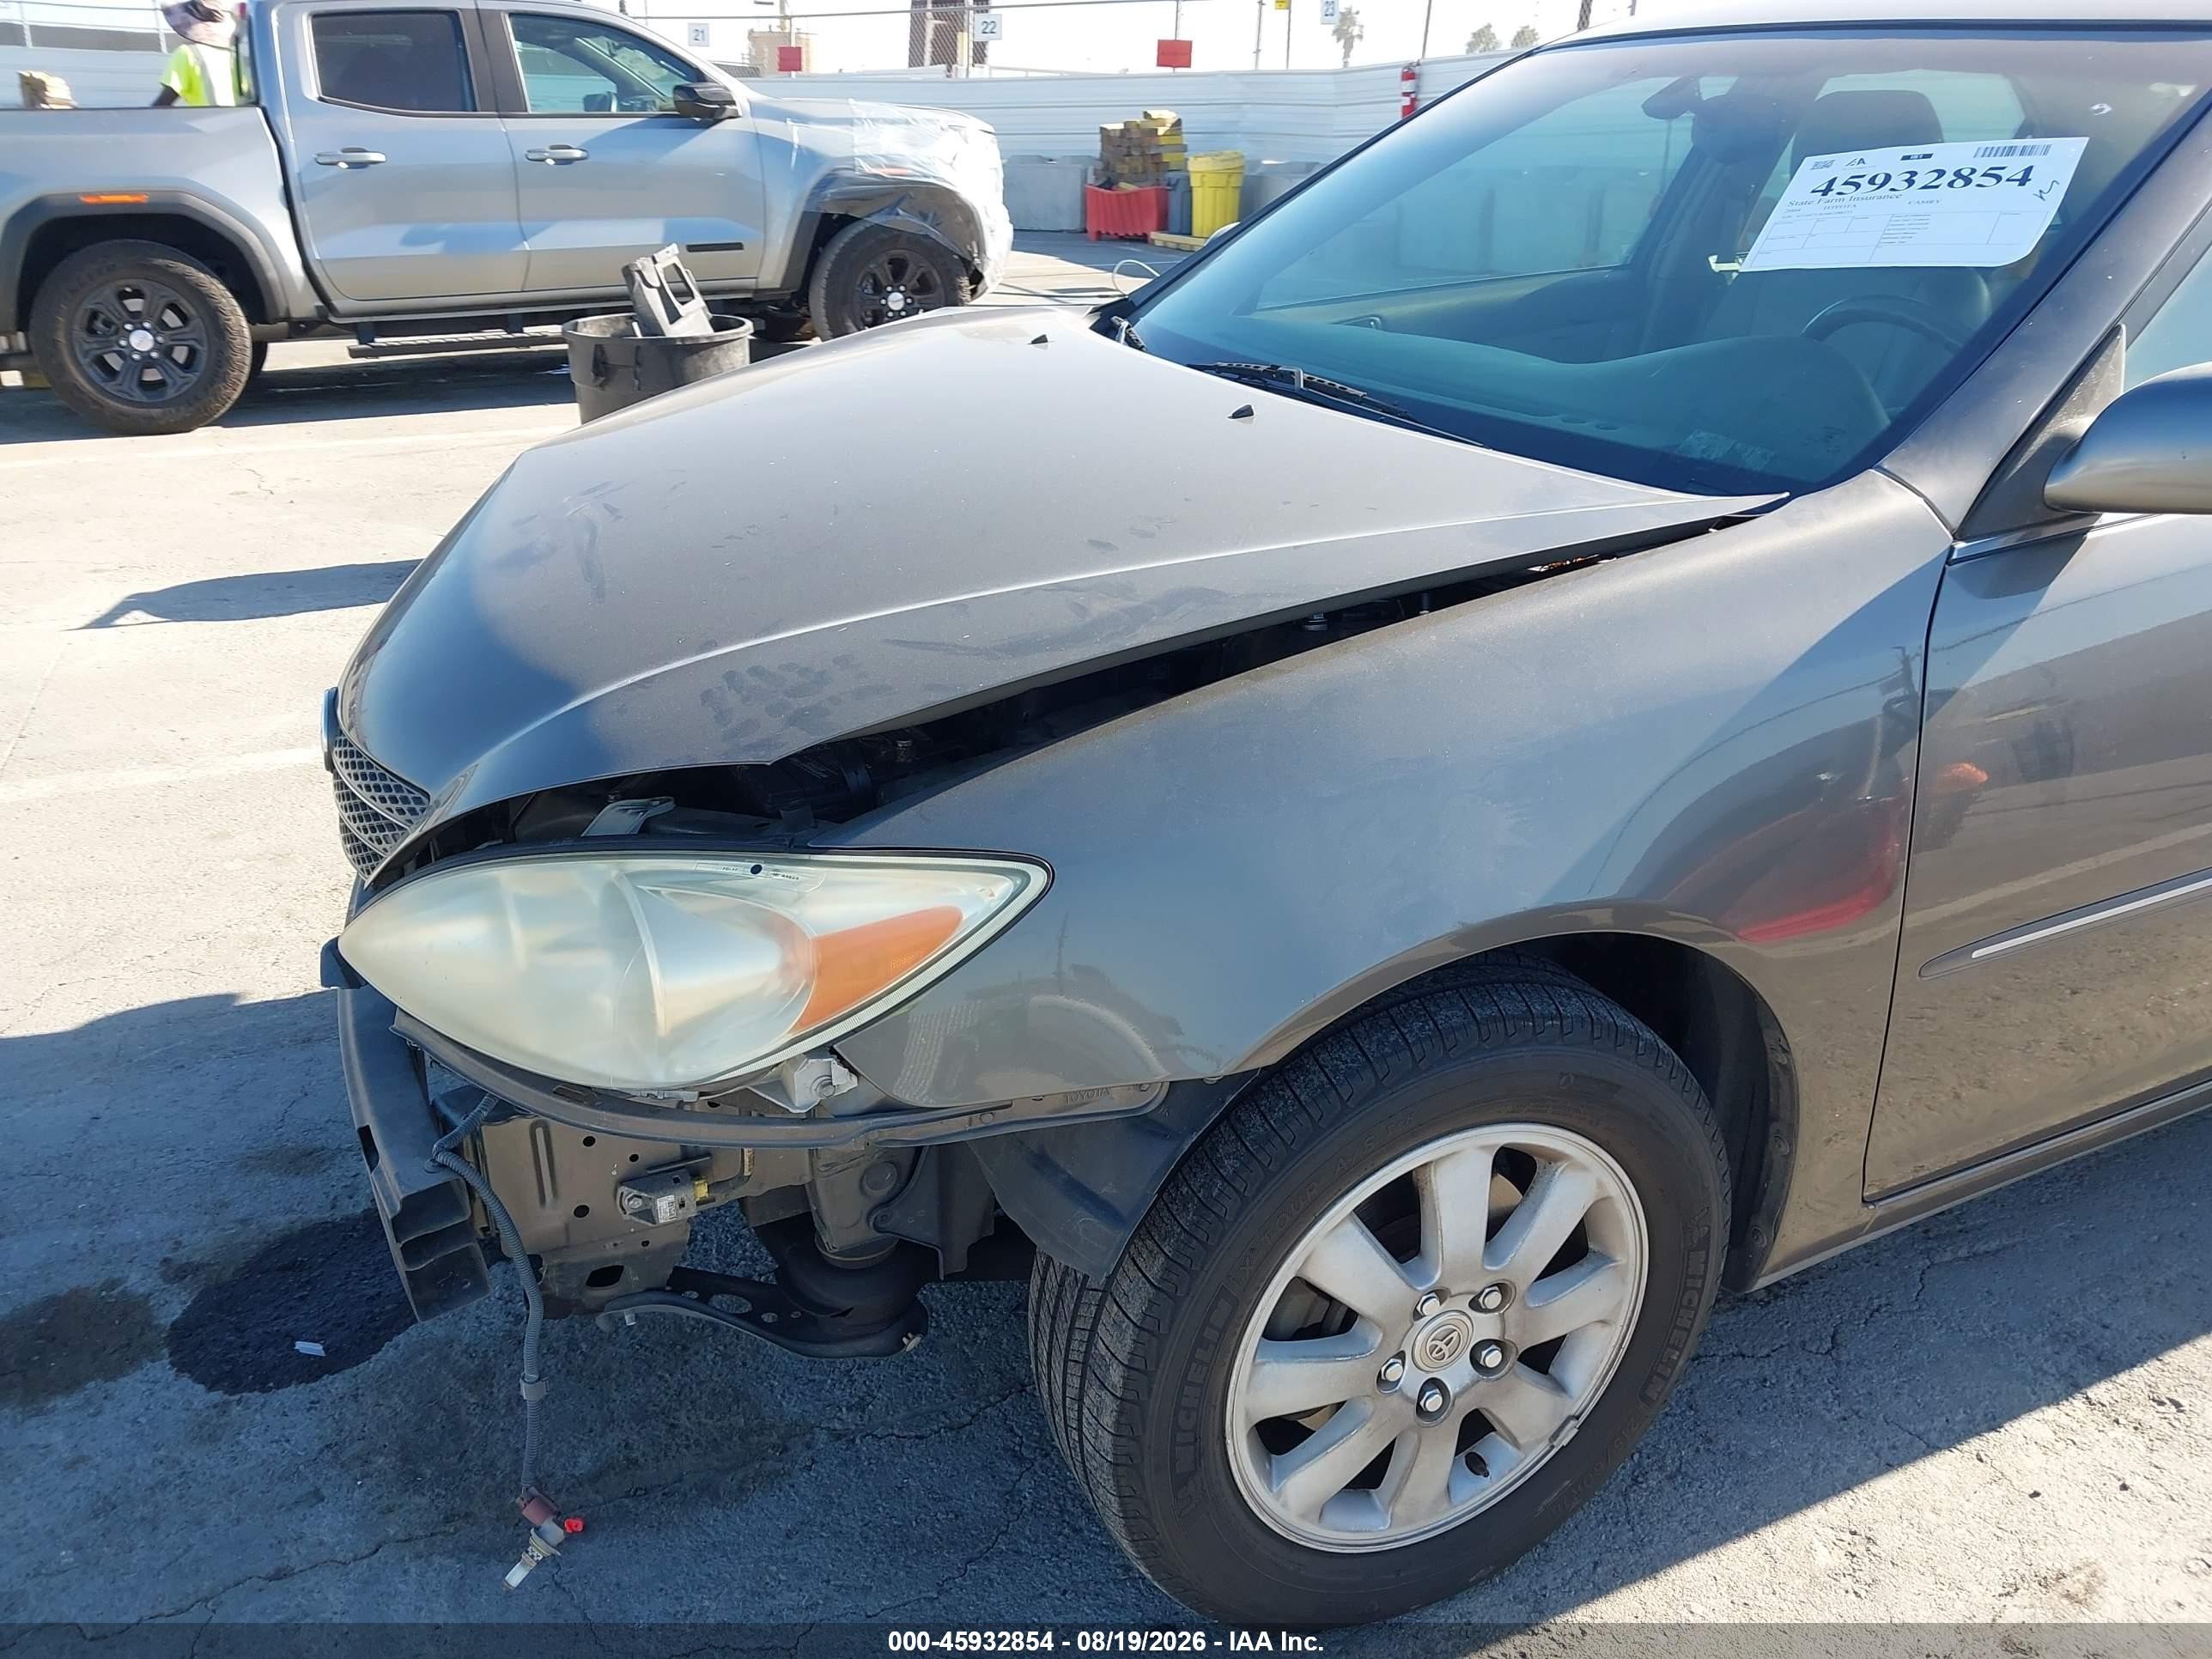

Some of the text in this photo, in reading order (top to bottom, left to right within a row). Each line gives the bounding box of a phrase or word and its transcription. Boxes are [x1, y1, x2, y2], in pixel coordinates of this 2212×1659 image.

[694, 28, 705, 41] 21
[981, 21, 996, 34] 22
[1810, 165, 2034, 197] 45932854
[1817, 197, 1845, 206] Farm
[1849, 193, 1904, 203] Insurance
[1644, 1249, 1706, 1403] MICHELIN
[1173, 1297, 1234, 1474] MICHELIN
